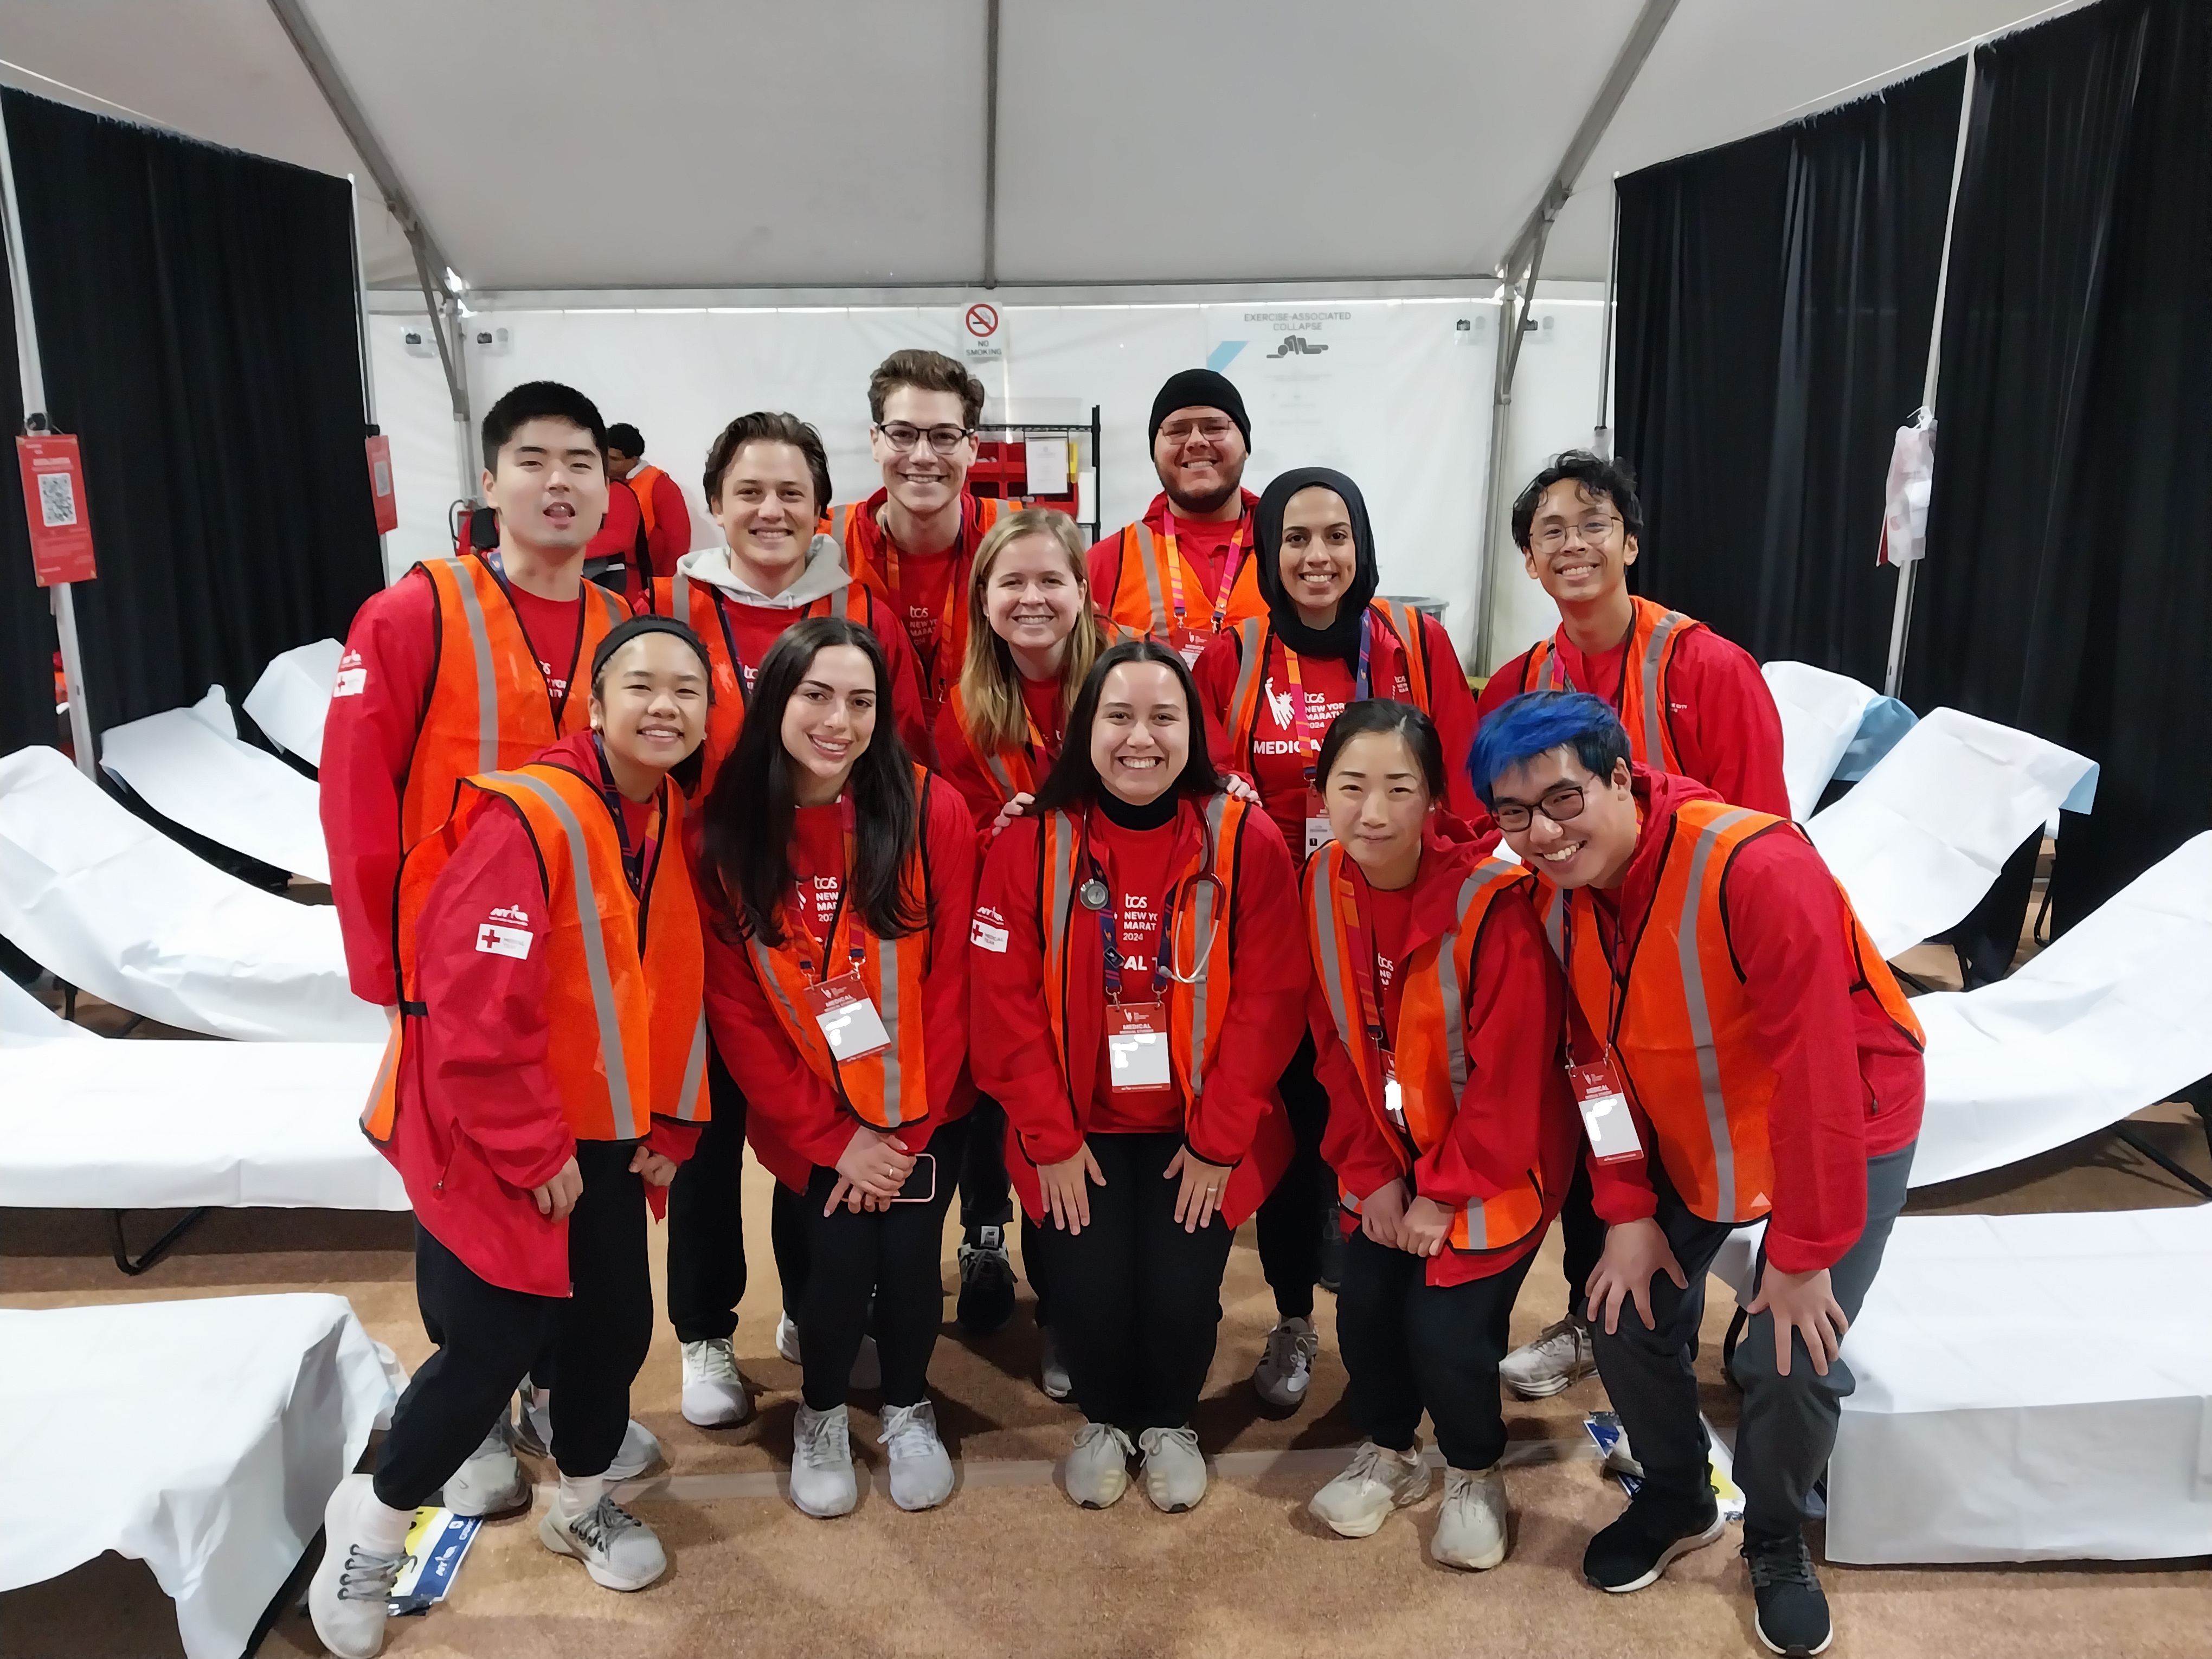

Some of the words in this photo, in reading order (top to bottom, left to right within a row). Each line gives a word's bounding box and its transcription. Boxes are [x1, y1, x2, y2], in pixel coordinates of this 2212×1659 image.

[1273, 322, 1323, 331] COLLAPSE
[910, 605, 929, 619] tcs
[1304, 692, 1326, 704] tcs
[1305, 705, 1326, 713] NEW
[1326, 703, 1347, 711] YOR
[814, 875, 838, 890] tcs
[815, 892, 839, 901] NEW
[1125, 893, 1148, 909] tcs
[1124, 911, 1147, 920] NEW
[1123, 933, 1143, 941] 2024
